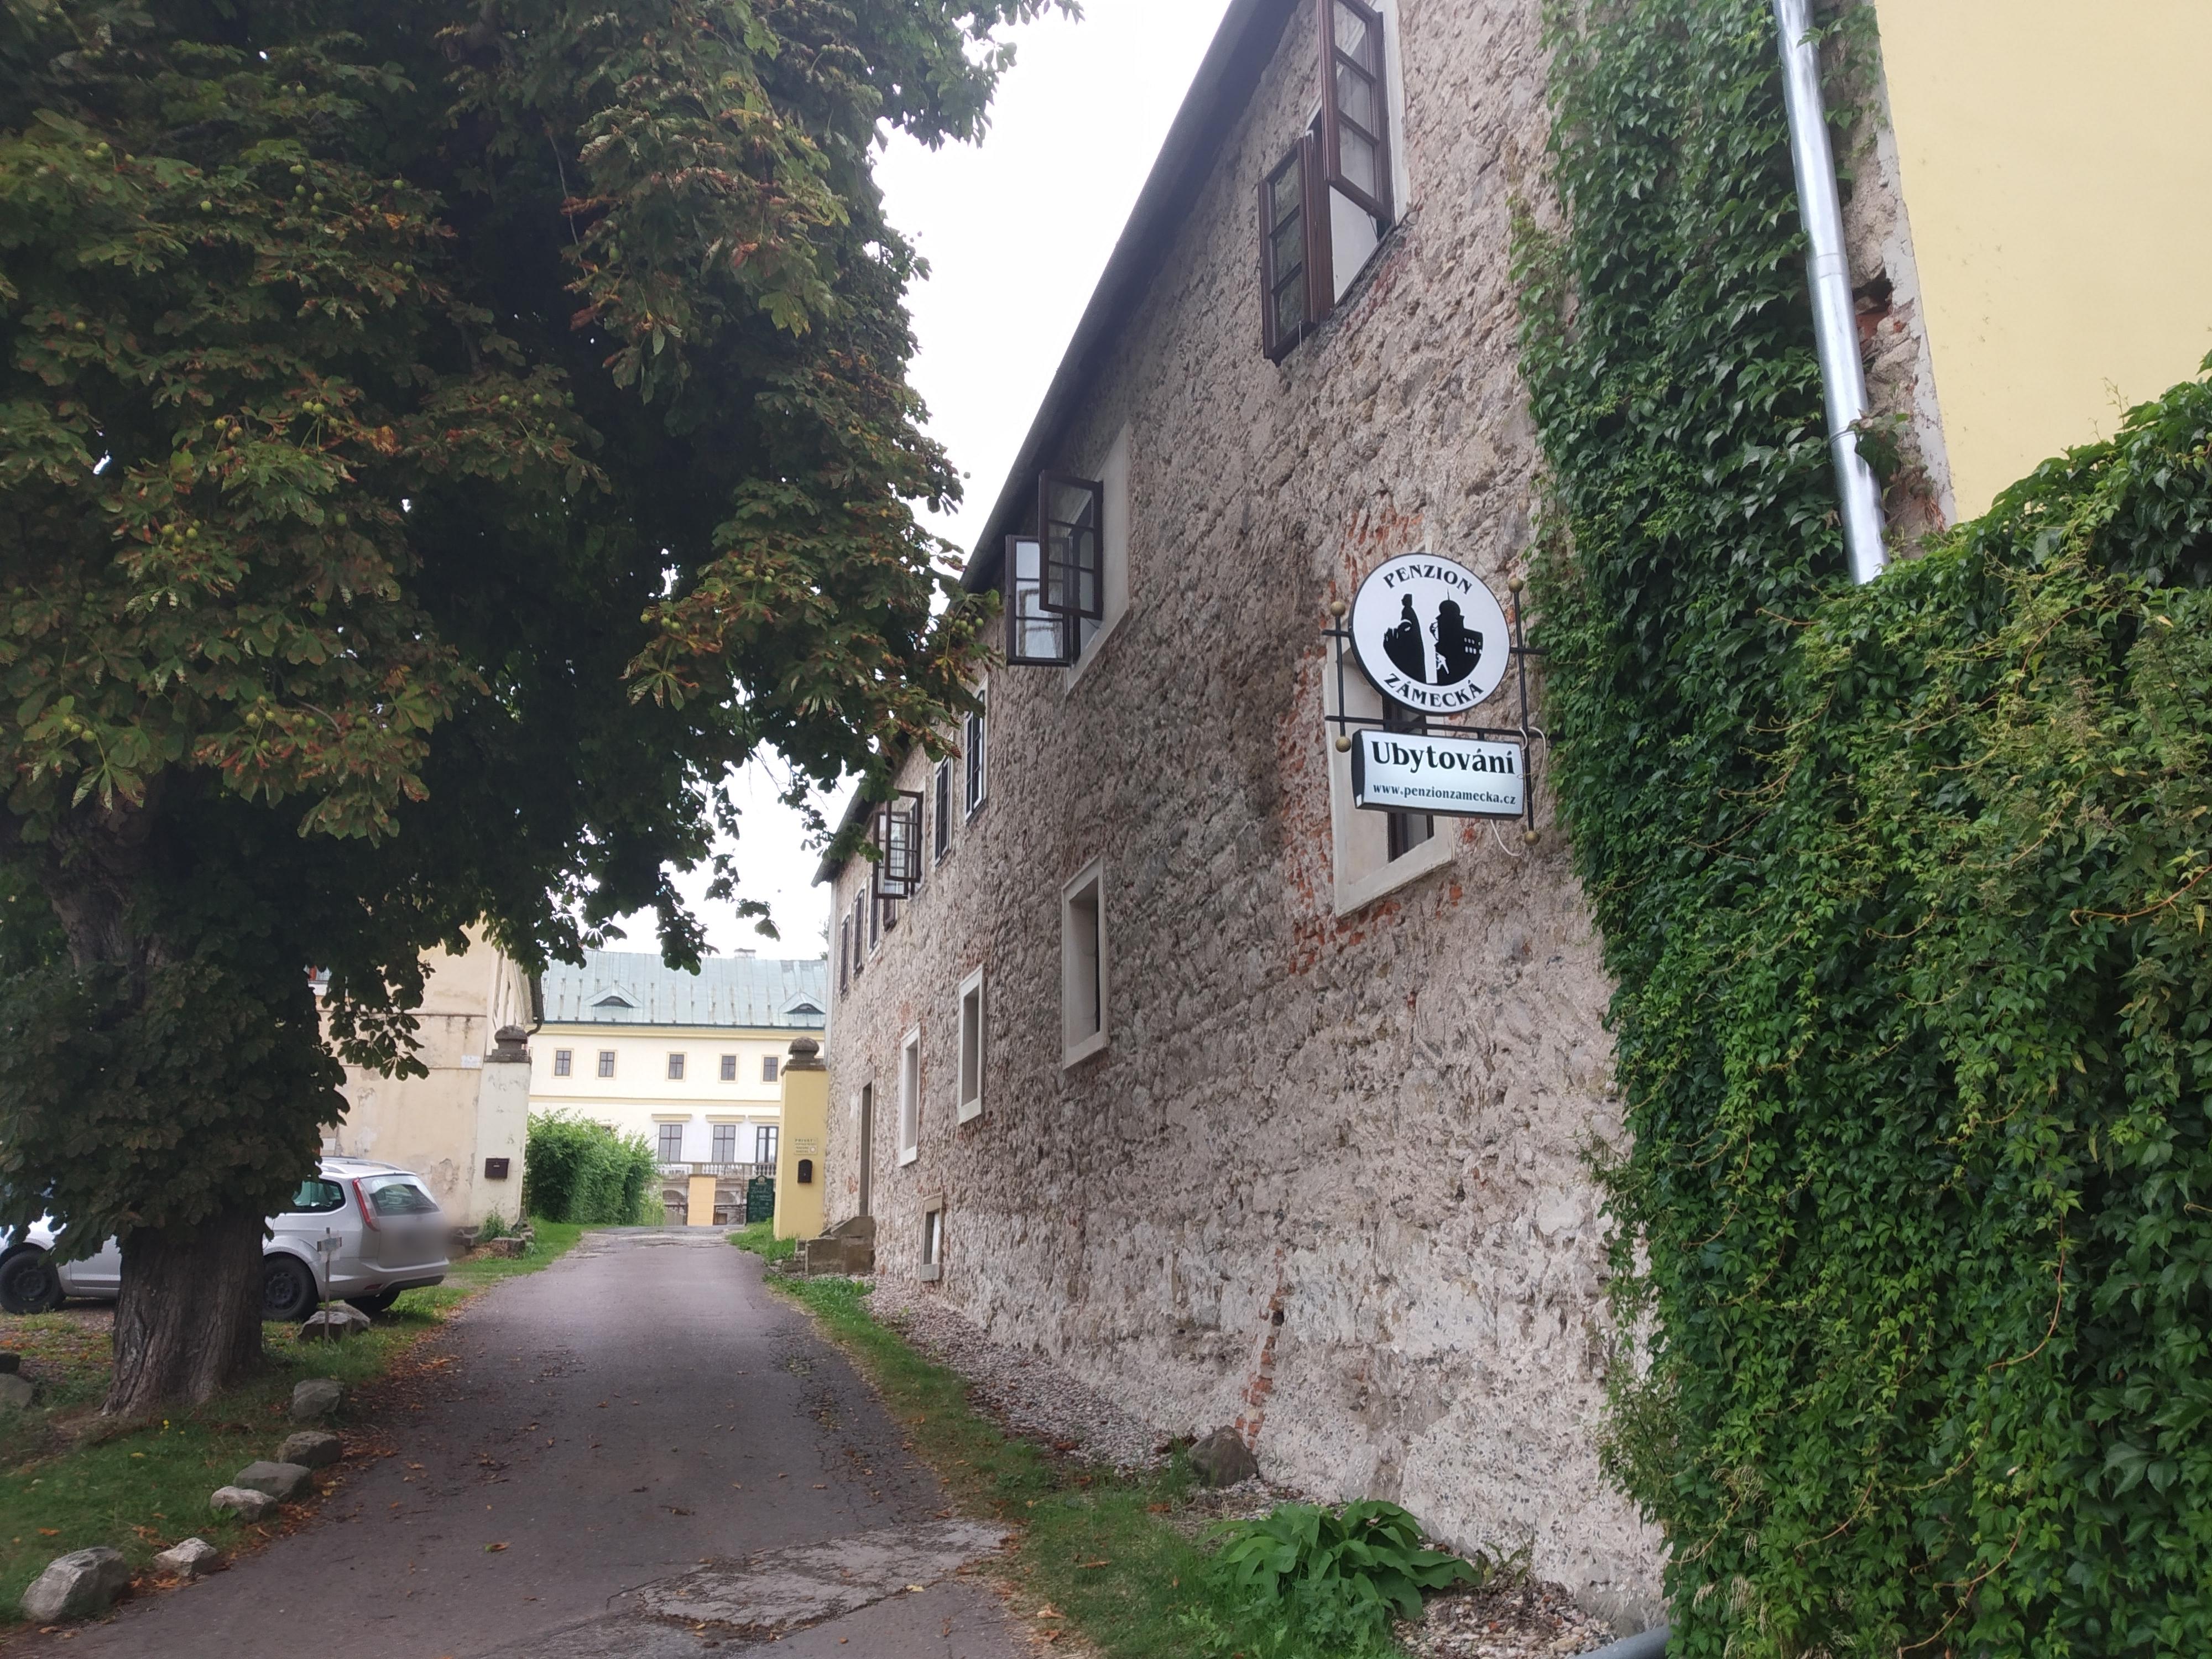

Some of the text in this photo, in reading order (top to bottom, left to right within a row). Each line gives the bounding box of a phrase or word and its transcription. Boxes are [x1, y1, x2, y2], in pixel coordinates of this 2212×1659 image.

[1383, 565, 1472, 595] PENZION
[1384, 673, 1484, 707] ZÁMECKÁ
[1371, 741, 1516, 774] Ubytování
[1373, 784, 1516, 805] www.penzionzamecka.cz
